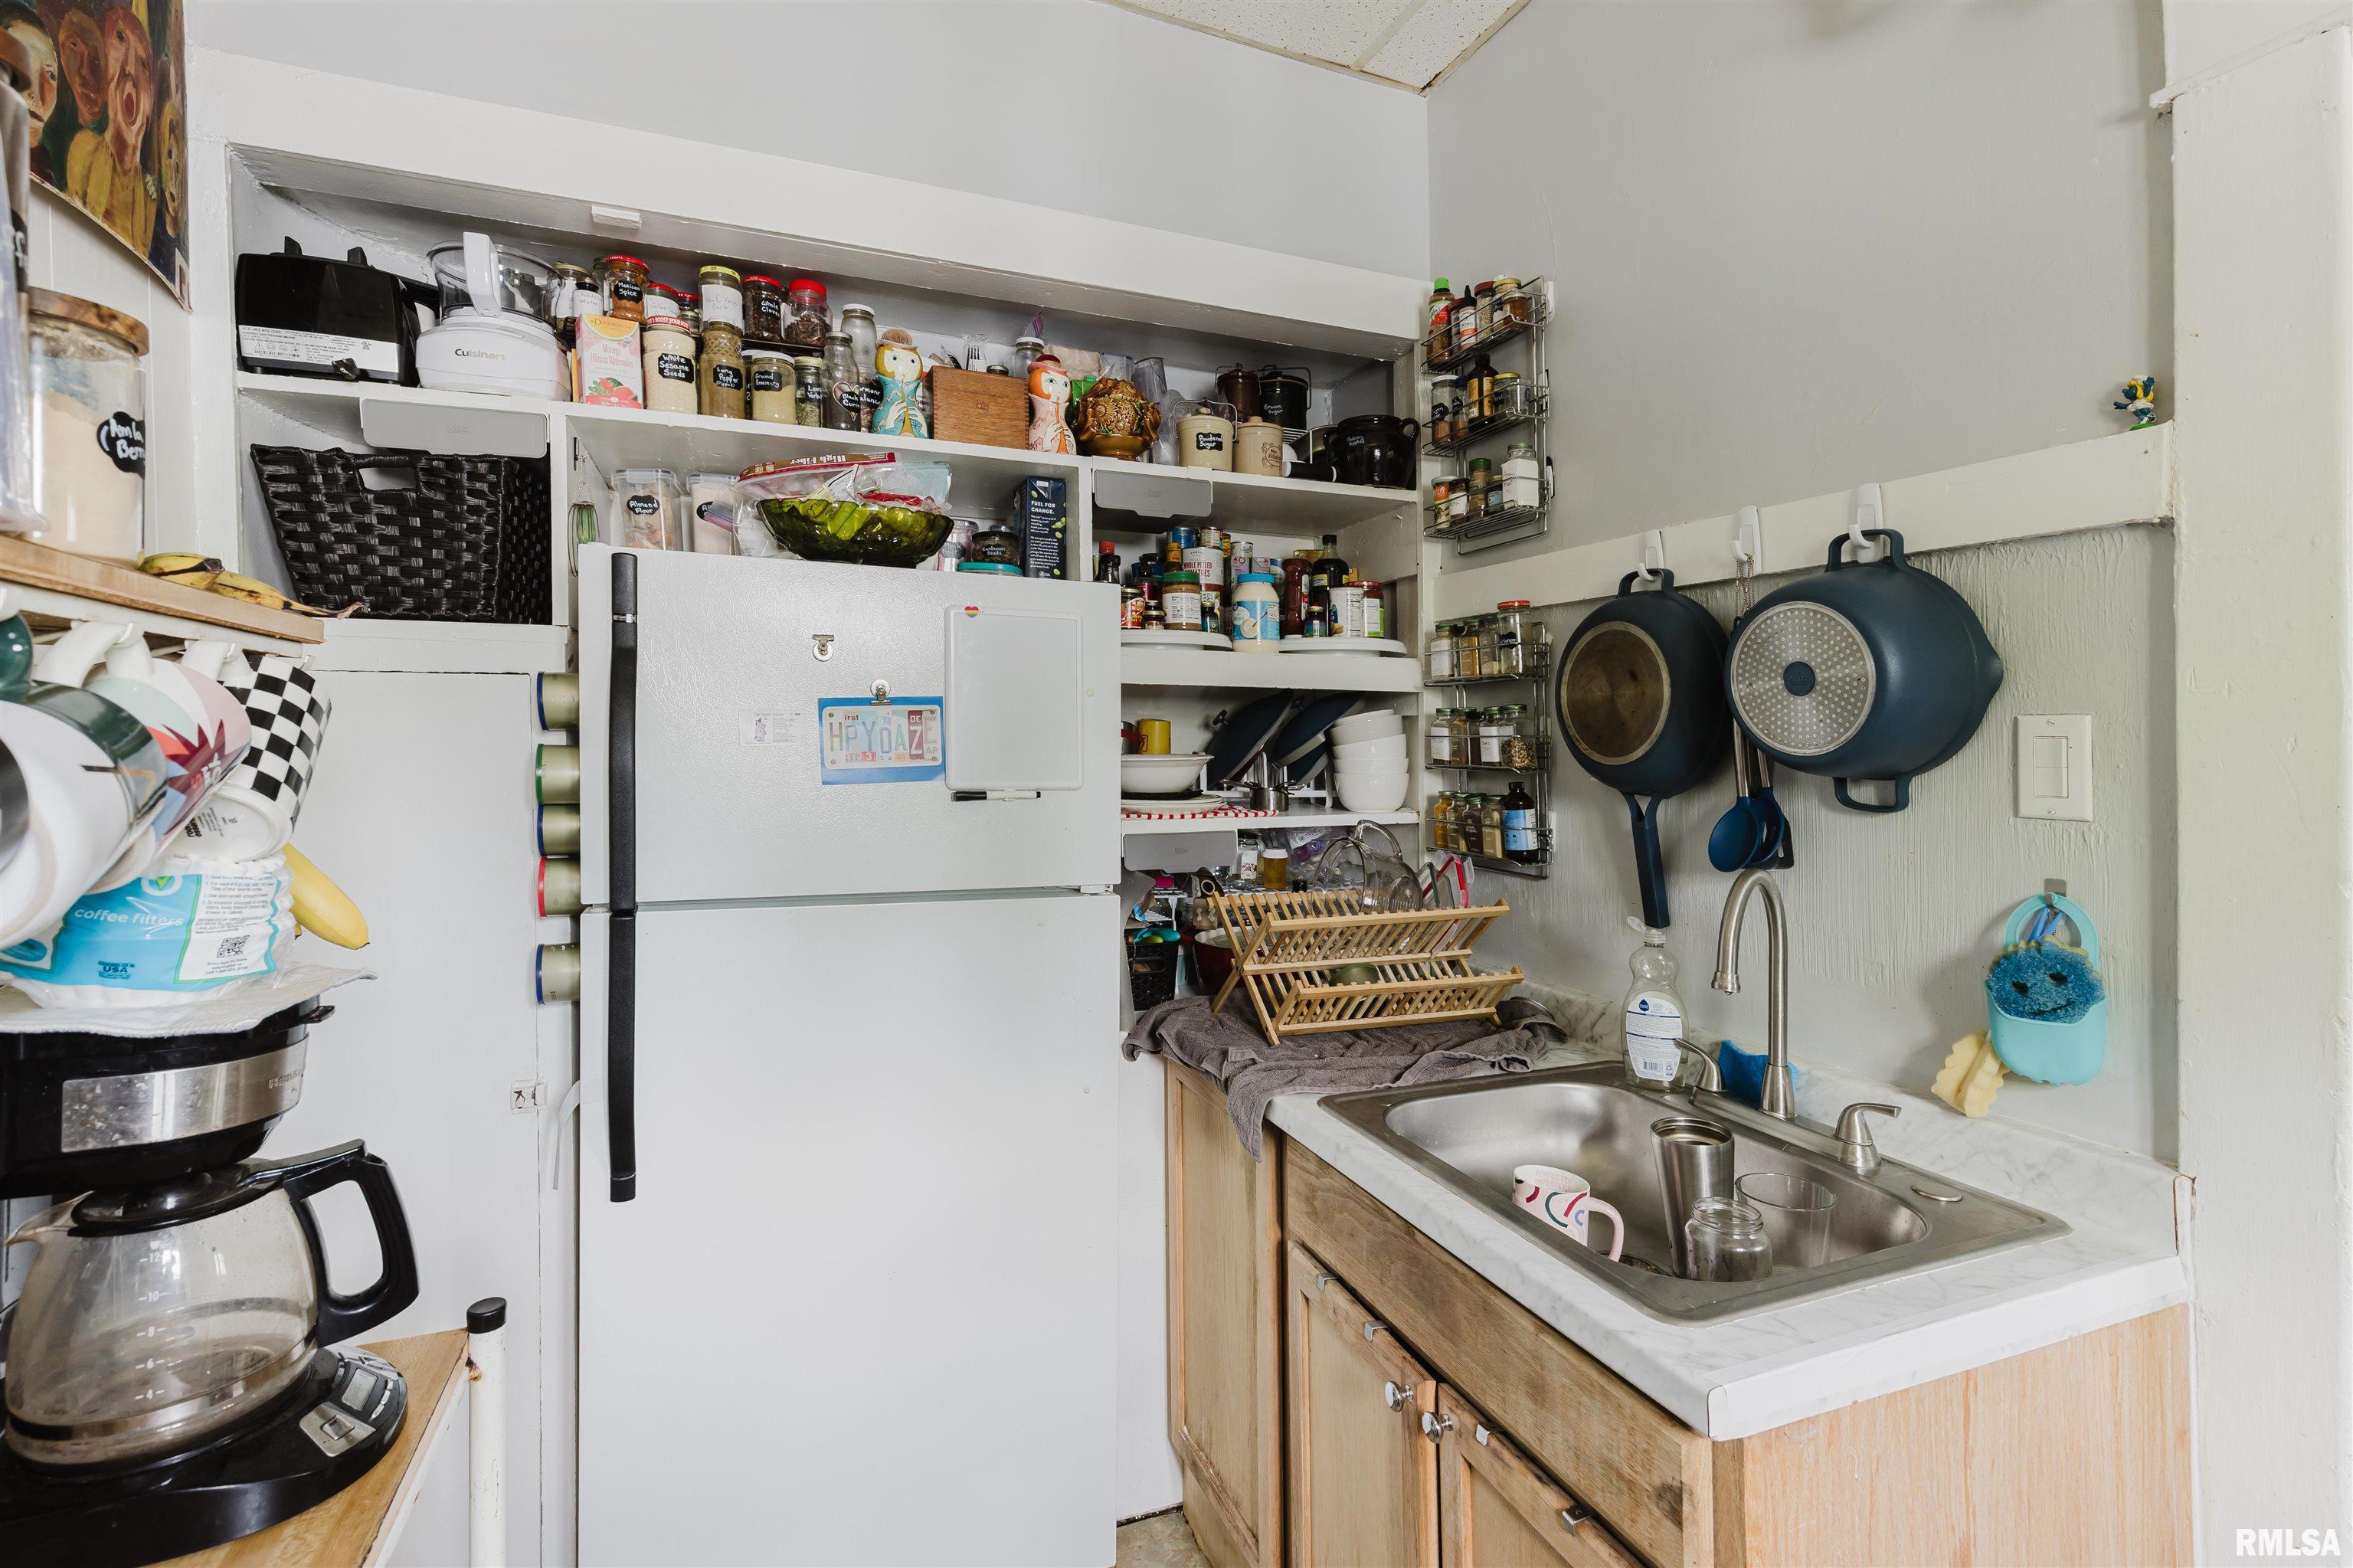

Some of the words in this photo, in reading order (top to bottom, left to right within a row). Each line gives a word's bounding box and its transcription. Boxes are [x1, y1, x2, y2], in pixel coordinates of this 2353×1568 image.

[618, 281, 640, 291] Mexican
[761, 301, 779, 310] Whole
[761, 306, 780, 317] Cloves
[455, 349, 506, 361] Cuisinart
[663, 354, 686, 363] White
[659, 361, 689, 372] Sesame
[663, 368, 686, 378] Seeds
[717, 367, 734, 377] Long
[719, 373, 738, 383] Pepper
[790, 457, 817, 466] Fiber
[820, 454, 846, 464] High
[630, 499, 659, 508] Almond
[74, 909, 129, 923] coffee
[132, 913, 185, 926] filters
[150, 1252, 160, 1262] 12
[149, 1291, 159, 1301] 10
[148, 1327, 155, 1337] 8
[147, 1358, 154, 1368] 6
[146, 1390, 153, 1400] 4
